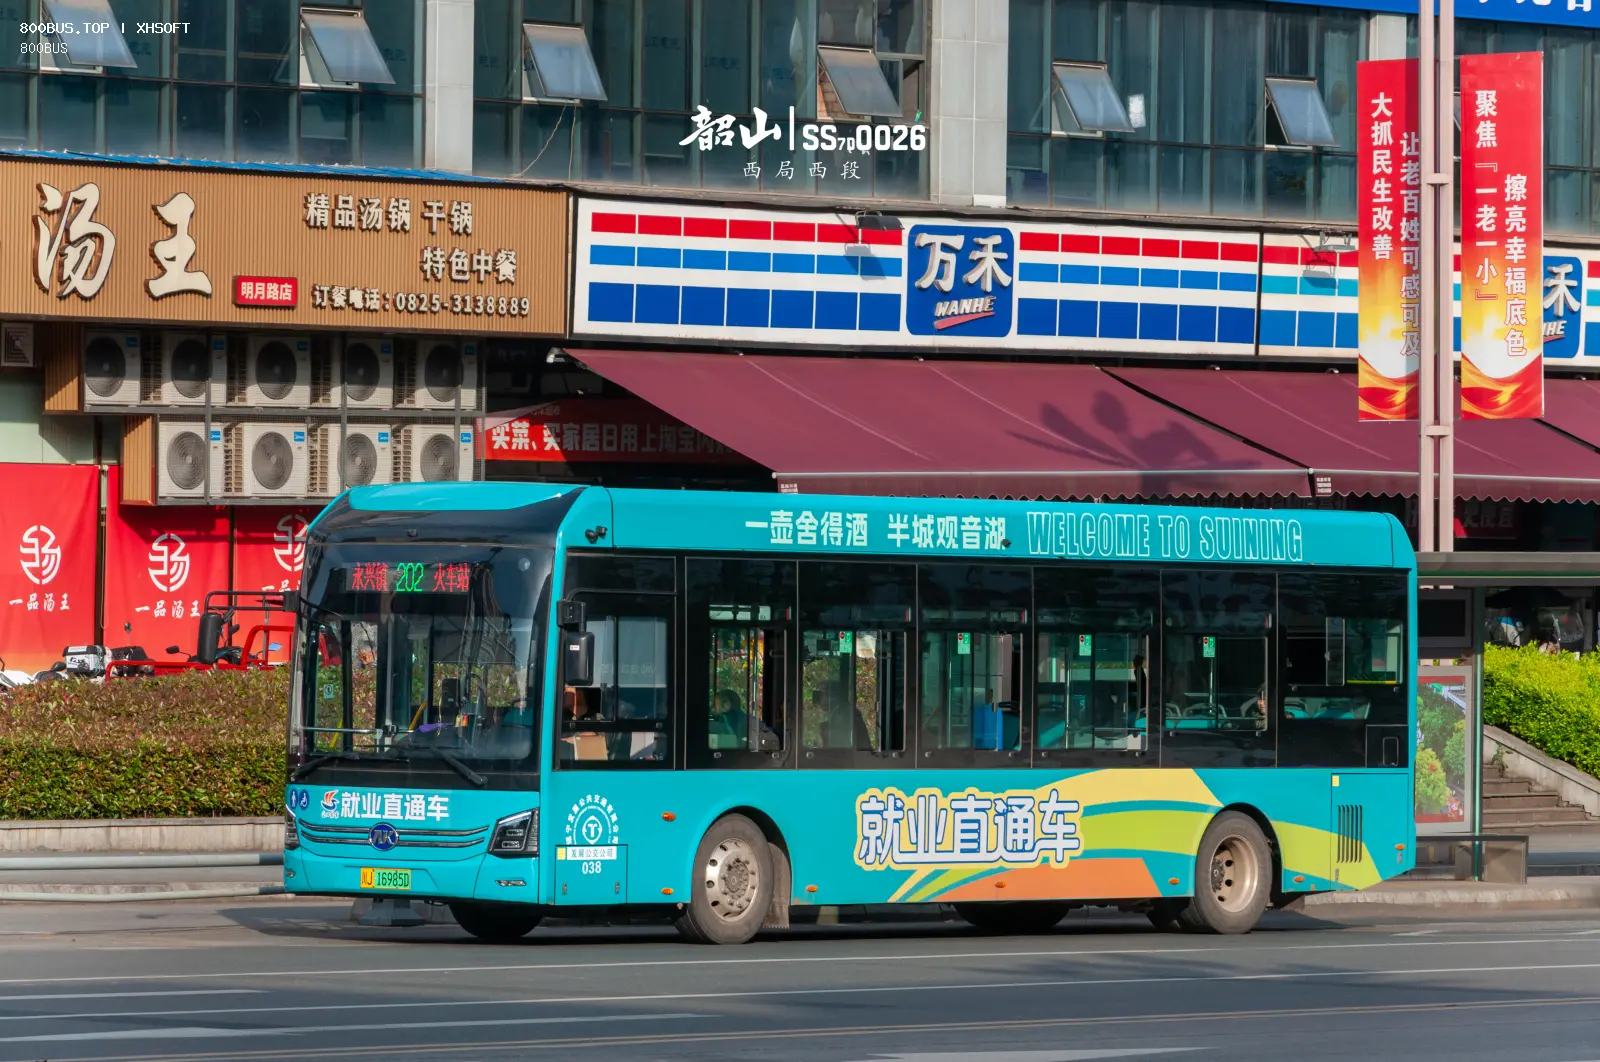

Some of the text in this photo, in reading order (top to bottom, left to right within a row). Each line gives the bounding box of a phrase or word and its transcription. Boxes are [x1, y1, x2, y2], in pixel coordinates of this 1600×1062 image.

[1371, 91, 1393, 261] 大抓民生改善
[303, 192, 473, 234] 精品汤锅 干锅
[34, 182, 212, 299] 汤王
[1400, 131, 1420, 357] 让老百姓可感可及
[422, 246, 517, 283] 特色中餐
[914, 232, 1012, 293] 万禾
[1504, 174, 1528, 357] 擦亮幸福底色
[240, 281, 293, 301] 明月路店
[935, 296, 995, 317] WANHE
[745, 510, 1006, 550] 一壶舍得酒 半城观音湖
[1026, 511, 1303, 562] WELCOME TO SUINING
[396, 562, 424, 592] 202
[432, 562, 470, 593] 火车站
[9, 592, 70, 612] 一品汤王
[135, 599, 200, 619] 一品汤王
[341, 792, 450, 822] 就业直通车
[858, 788, 1081, 865] 就业直通车
[571, 848, 613, 858] 发展公交公司
[582, 860, 602, 875] 038
